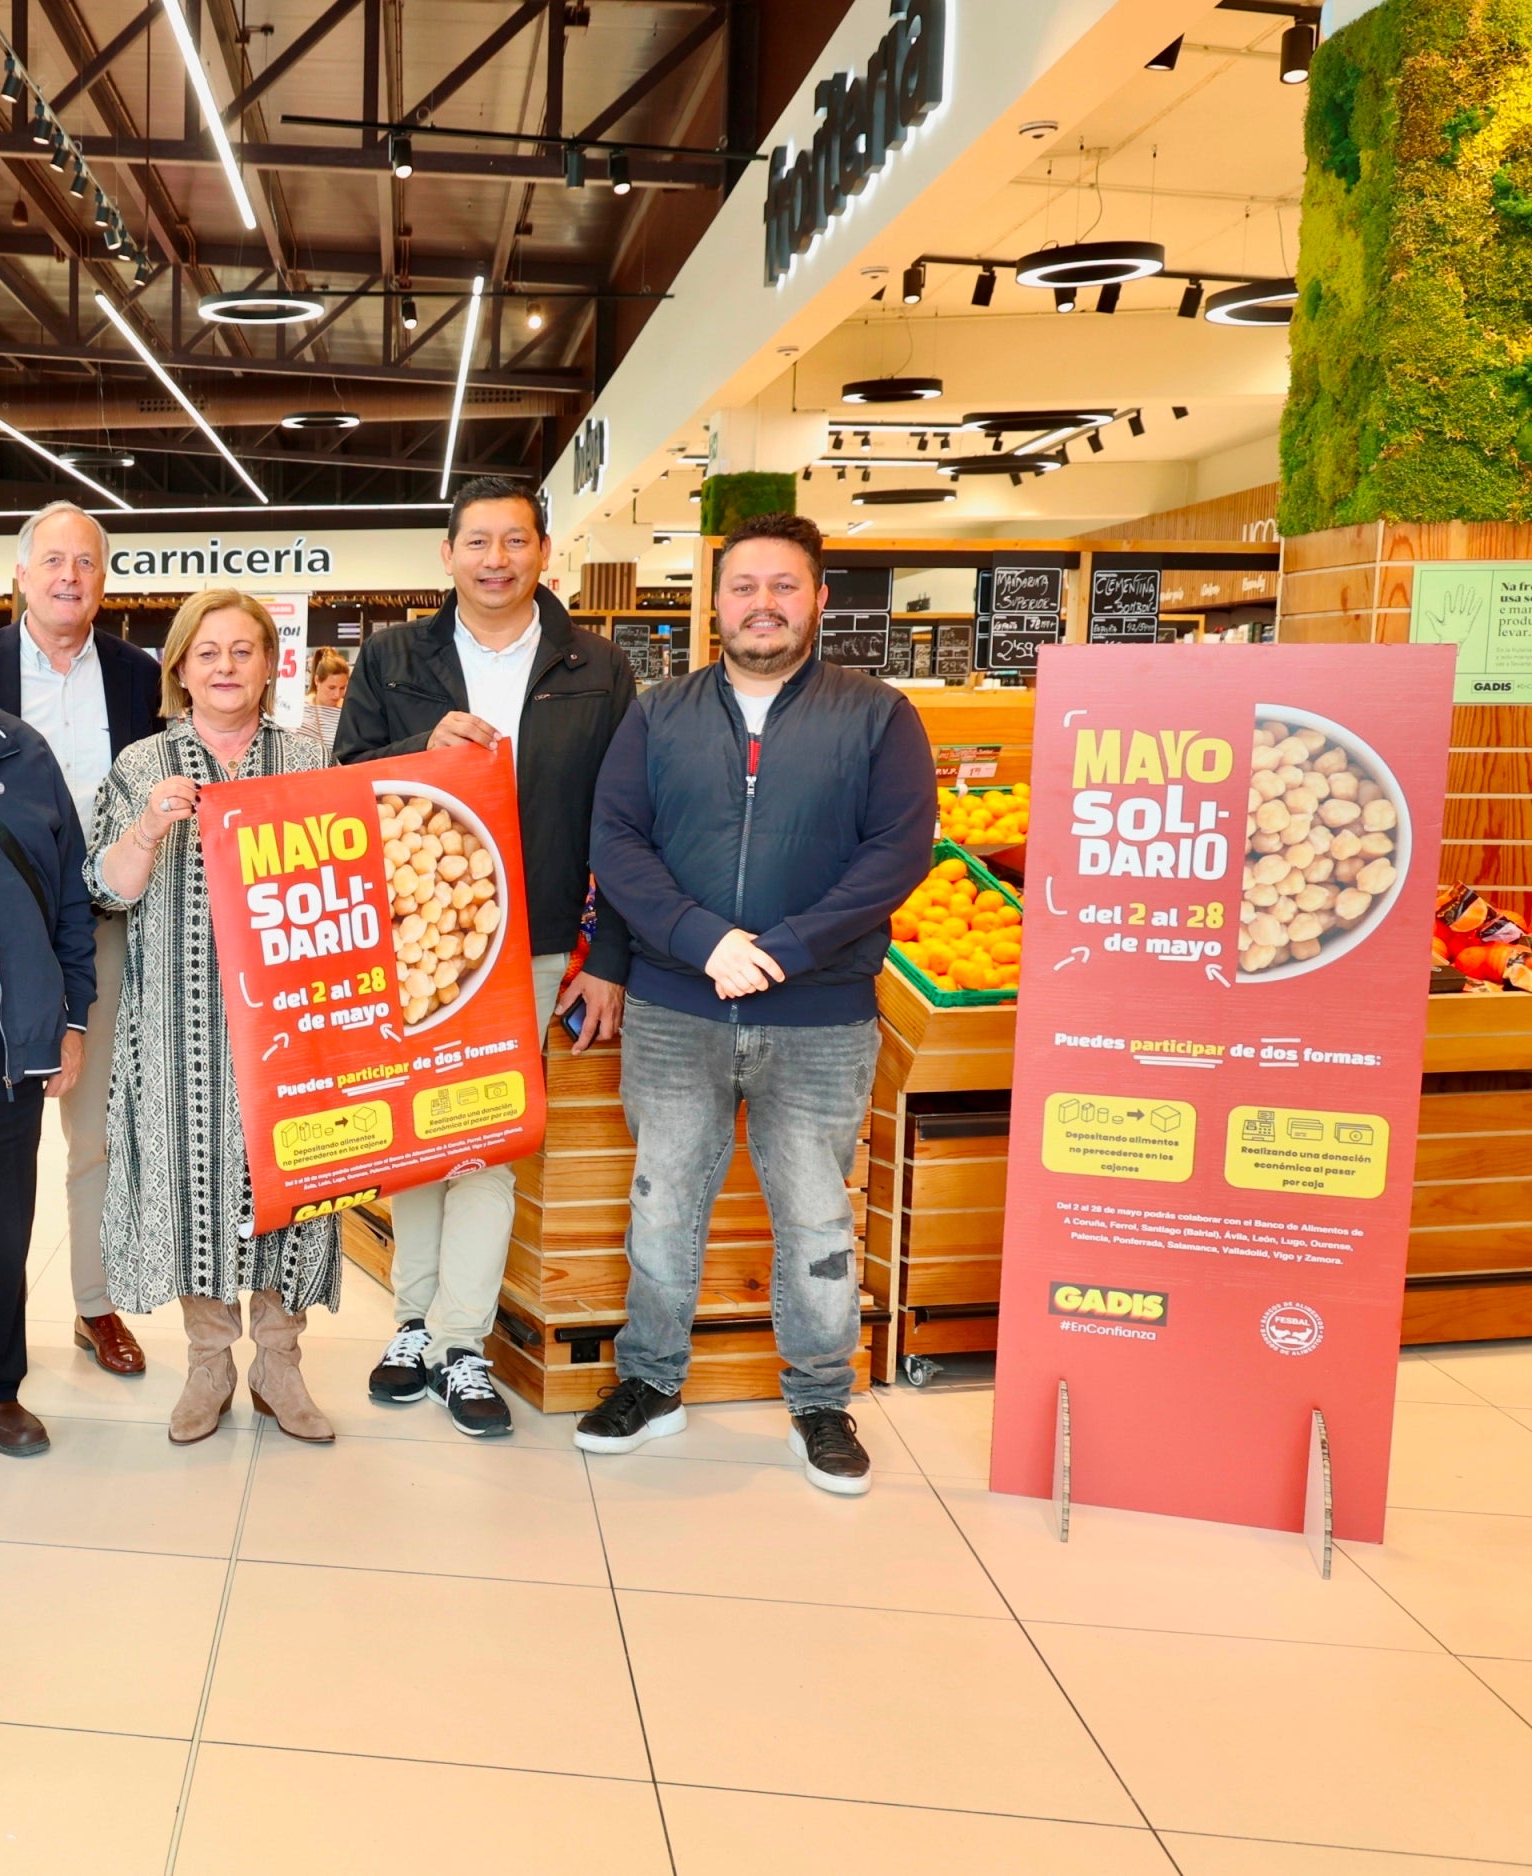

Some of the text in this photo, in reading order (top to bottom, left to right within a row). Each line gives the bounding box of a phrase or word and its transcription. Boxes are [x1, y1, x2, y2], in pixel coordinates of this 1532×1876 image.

[111, 538, 330, 576] carnicería
[1500, 595, 1521, 603] usa
[1502, 582, 1516, 591] Na
[1474, 682, 1512, 691] GADIS
[1073, 729, 1232, 788] MAYO
[1071, 785, 1229, 841] SOLI-
[237, 813, 367, 885] MAYO
[1079, 833, 1227, 880] DARIO
[247, 866, 373, 933] SOLI-
[1079, 902, 1223, 928] del 2 al 28
[261, 904, 379, 965] DARIO
[1104, 933, 1221, 961] de mayo
[273, 967, 386, 1010] del 2 al 28
[298, 1003, 389, 1032] de mayo
[1055, 1033, 1381, 1065] Puedes participar de dos formas:
[277, 1039, 519, 1098] Puedes participar de dos formas:
[1066, 1131, 1179, 1147] Depositando alimentos
[1083, 1148, 1143, 1159] perecederos
[1160, 1153, 1173, 1161] los
[1101, 1163, 1139, 1173] cajones
[1241, 1146, 1370, 1164] Realizando una donación
[1254, 1162, 1311, 1173] económica
[1325, 1168, 1355, 1176] pasar
[1283, 1180, 1324, 1190] por caja
[294, 1188, 379, 1223] GADIS
[1056, 1285, 1165, 1320] GADIS
[1061, 1321, 1156, 1340] #EnConfianza
[1275, 1316, 1310, 1326] FESBAL
